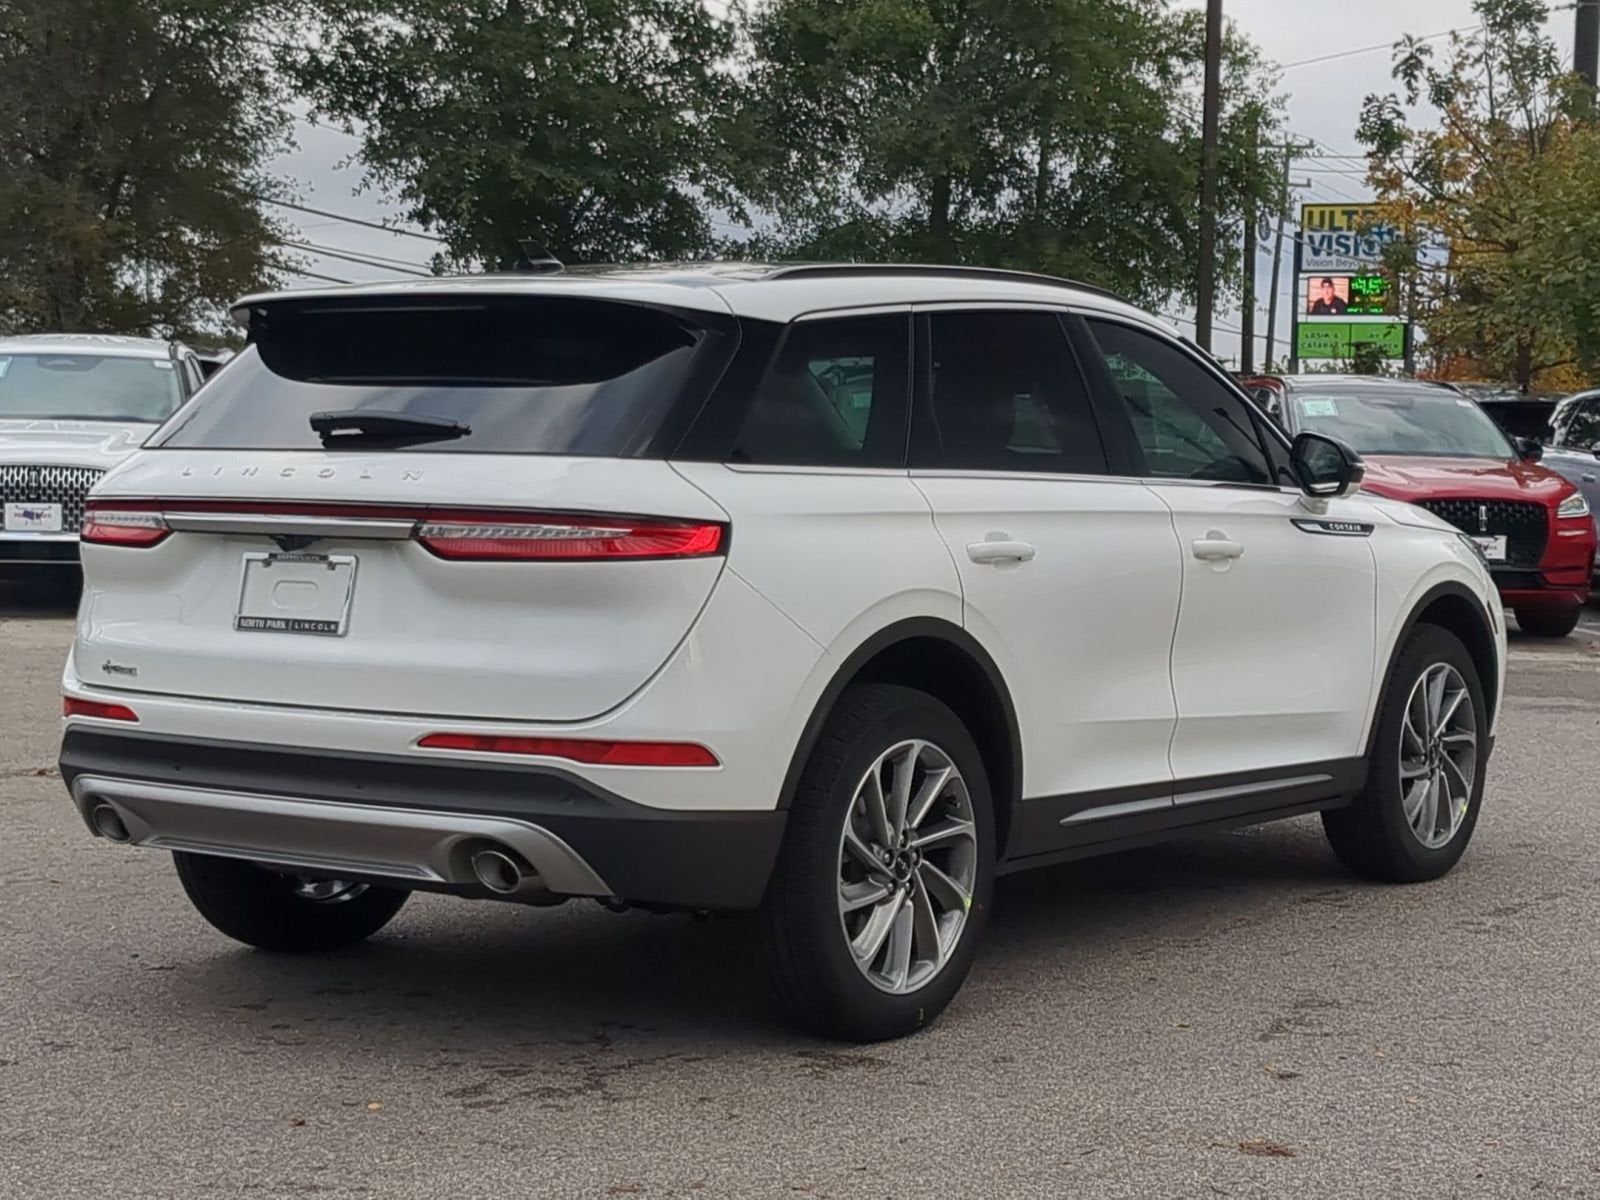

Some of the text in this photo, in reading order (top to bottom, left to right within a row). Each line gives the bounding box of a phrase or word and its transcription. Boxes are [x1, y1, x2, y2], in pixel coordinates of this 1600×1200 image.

[1306, 258, 1334, 268] Vision
[182, 466, 423, 481] LINCOLN
[1328, 523, 1362, 531] CORSAIR
[240, 618, 337, 631] NORTH PARK LINCOLN
